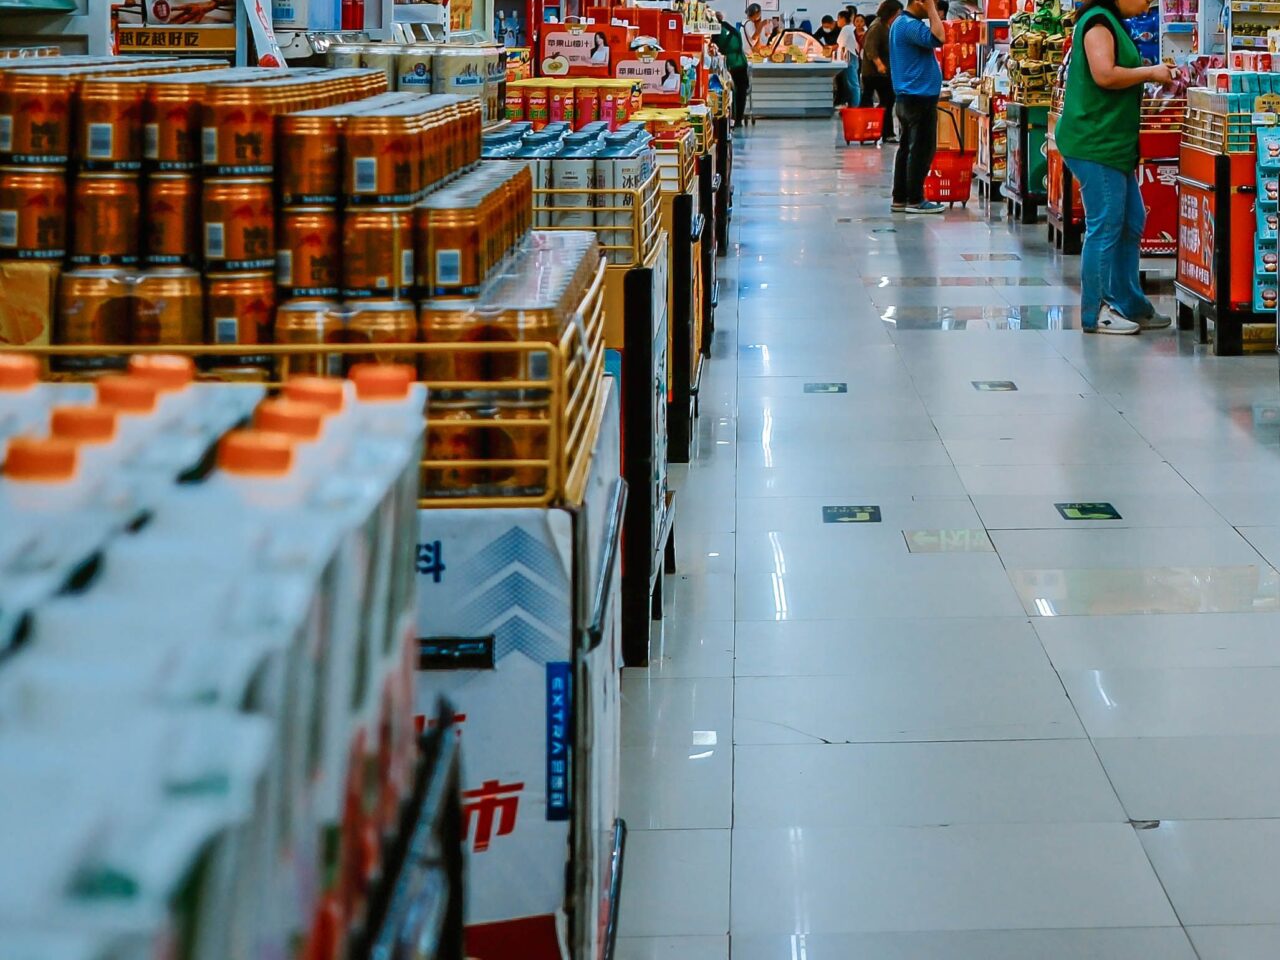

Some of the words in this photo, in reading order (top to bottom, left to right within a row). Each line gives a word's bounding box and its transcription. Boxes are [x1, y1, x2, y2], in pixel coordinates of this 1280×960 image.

[119, 31, 199, 47] 越吃越好吃
[548, 39, 589, 48] 苹果山楂汁
[619, 67, 661, 76] 苹果山楂汁
